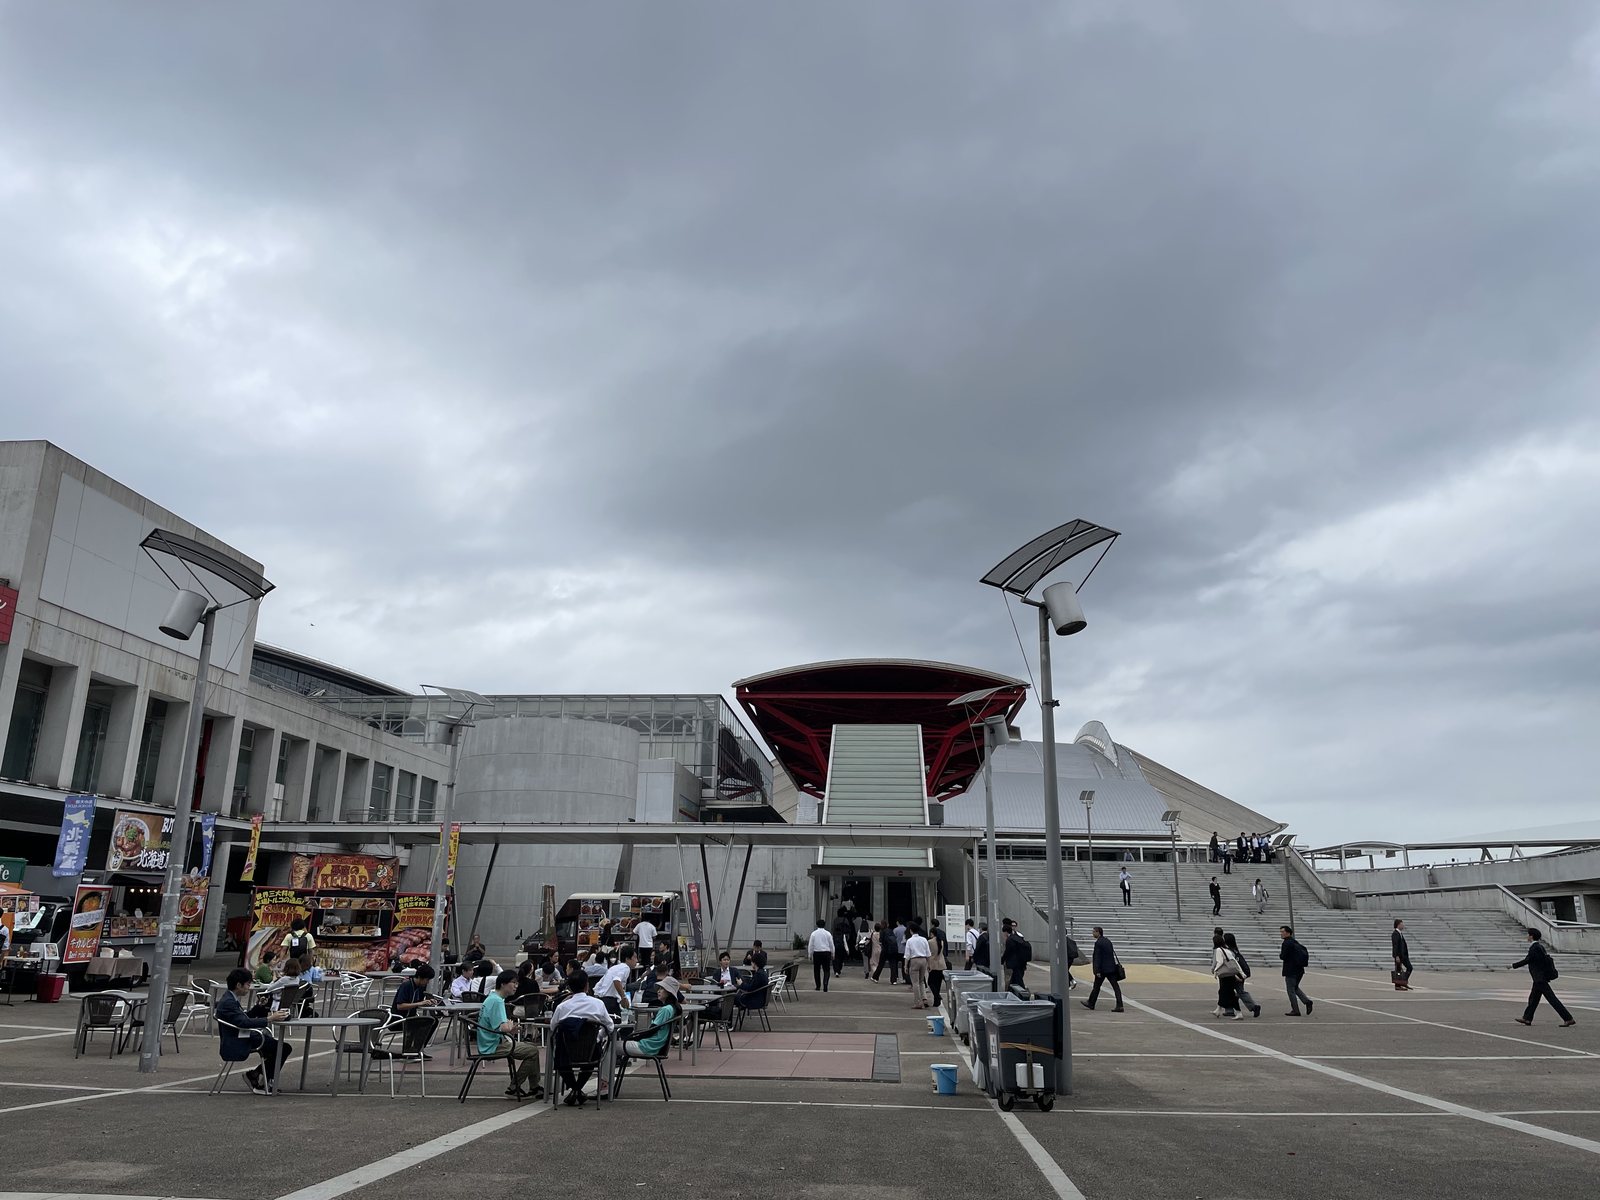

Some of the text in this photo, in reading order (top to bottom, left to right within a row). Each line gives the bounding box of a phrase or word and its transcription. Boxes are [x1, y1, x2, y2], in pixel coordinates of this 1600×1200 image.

[137, 850, 170, 869] 北海道
[320, 874, 367, 889] KEBAB
